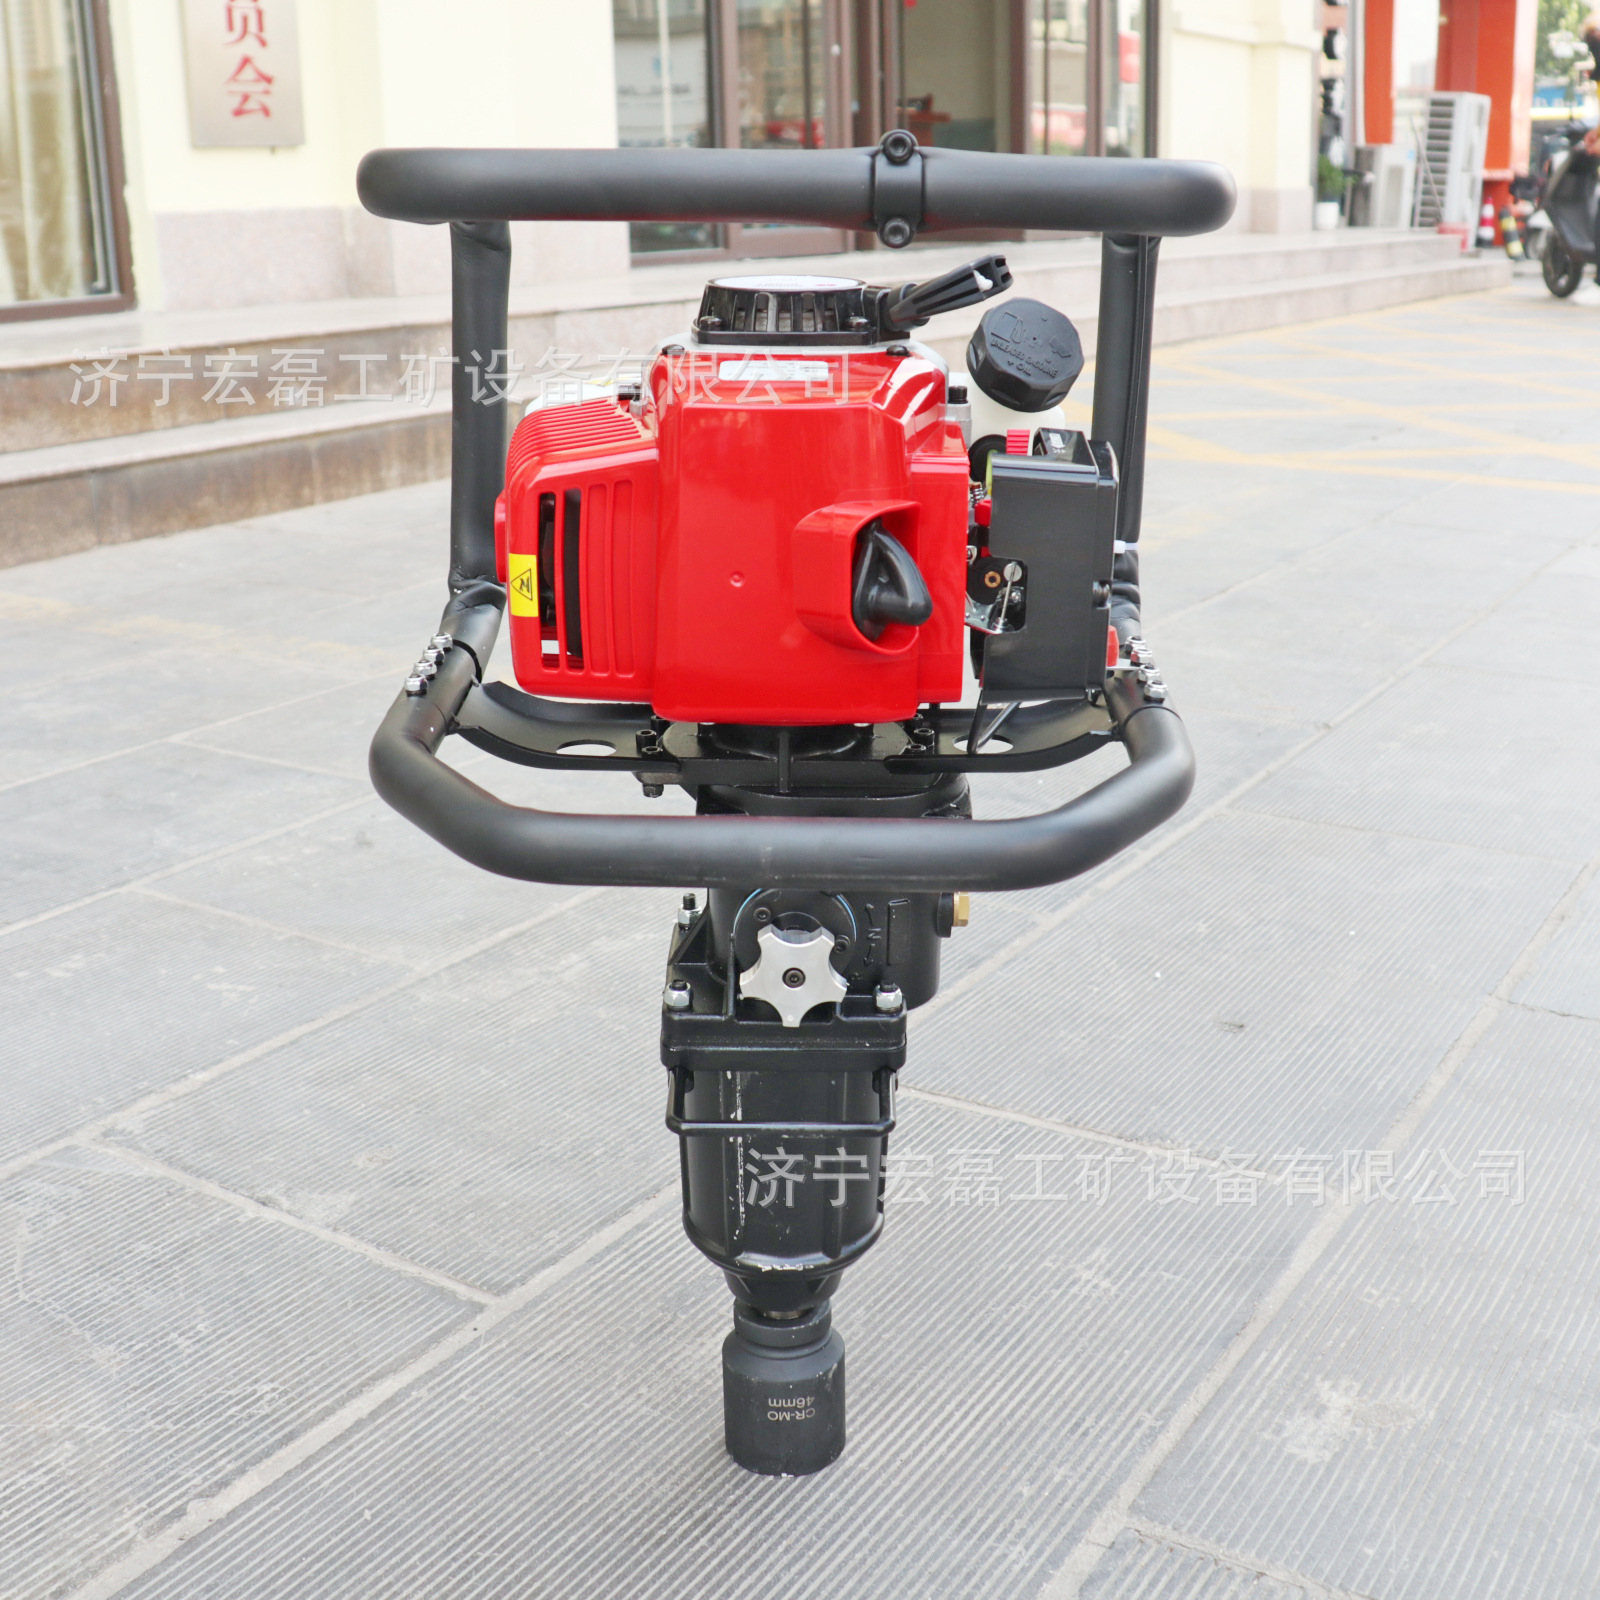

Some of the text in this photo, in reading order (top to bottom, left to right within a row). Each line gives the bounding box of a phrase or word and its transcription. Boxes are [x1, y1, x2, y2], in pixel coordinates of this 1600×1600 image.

[1016, 363, 1032, 376] OIL
[768, 1396, 815, 1408] 46mm
[767, 1408, 816, 1421] CR-MO
